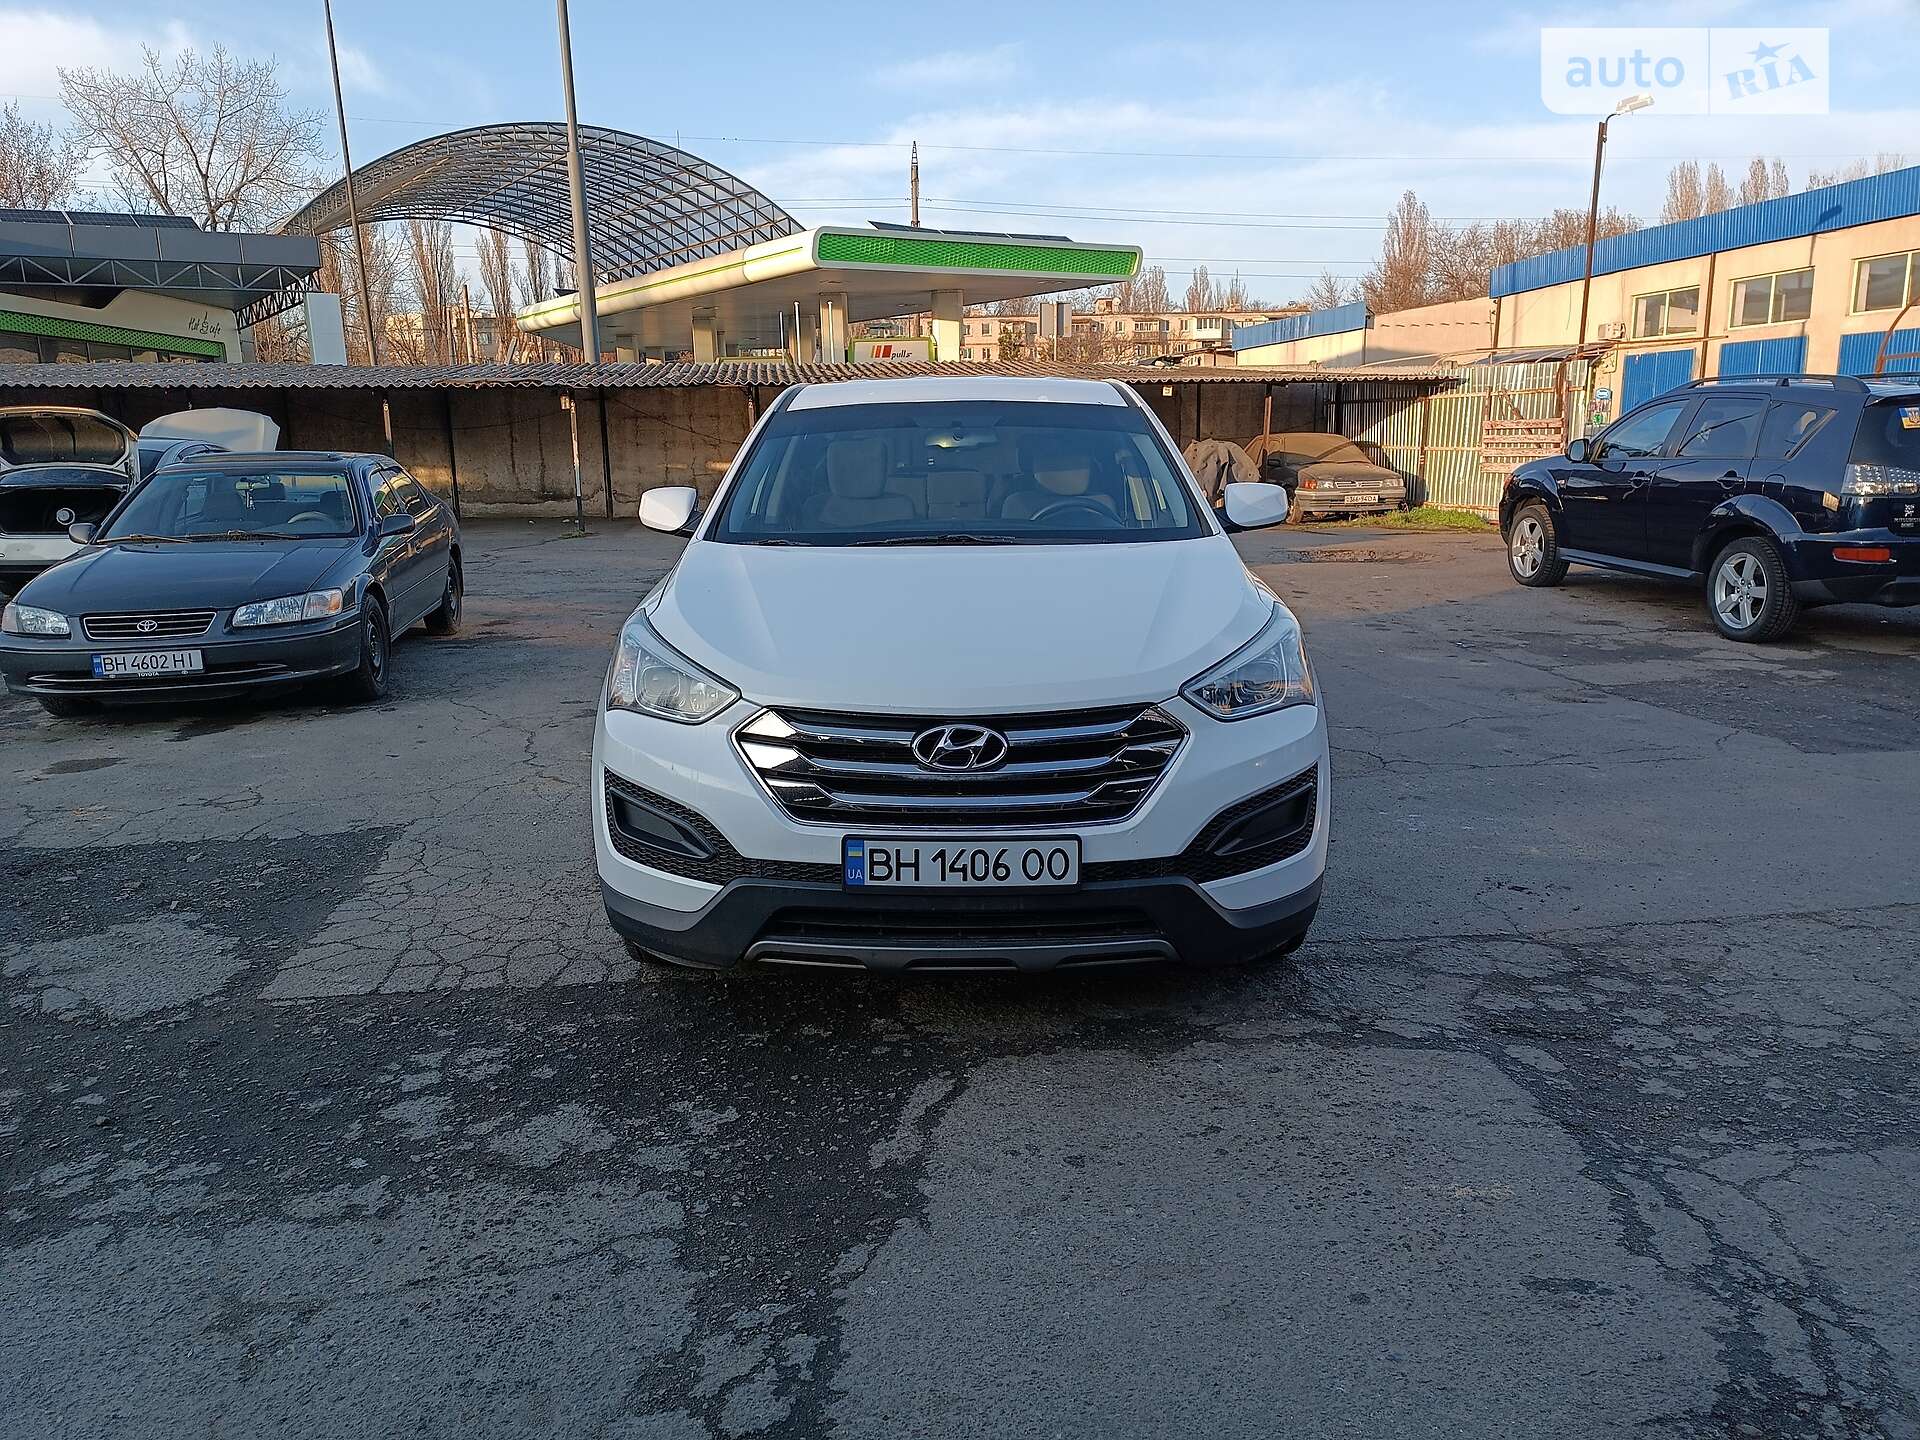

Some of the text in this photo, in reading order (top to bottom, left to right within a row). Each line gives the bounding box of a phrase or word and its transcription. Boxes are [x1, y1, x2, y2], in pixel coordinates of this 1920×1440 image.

[102, 652, 193, 672] BH 4602 HI
[847, 868, 863, 880] UA
[868, 848, 920, 882] BH
[931, 848, 1011, 882] 1406
